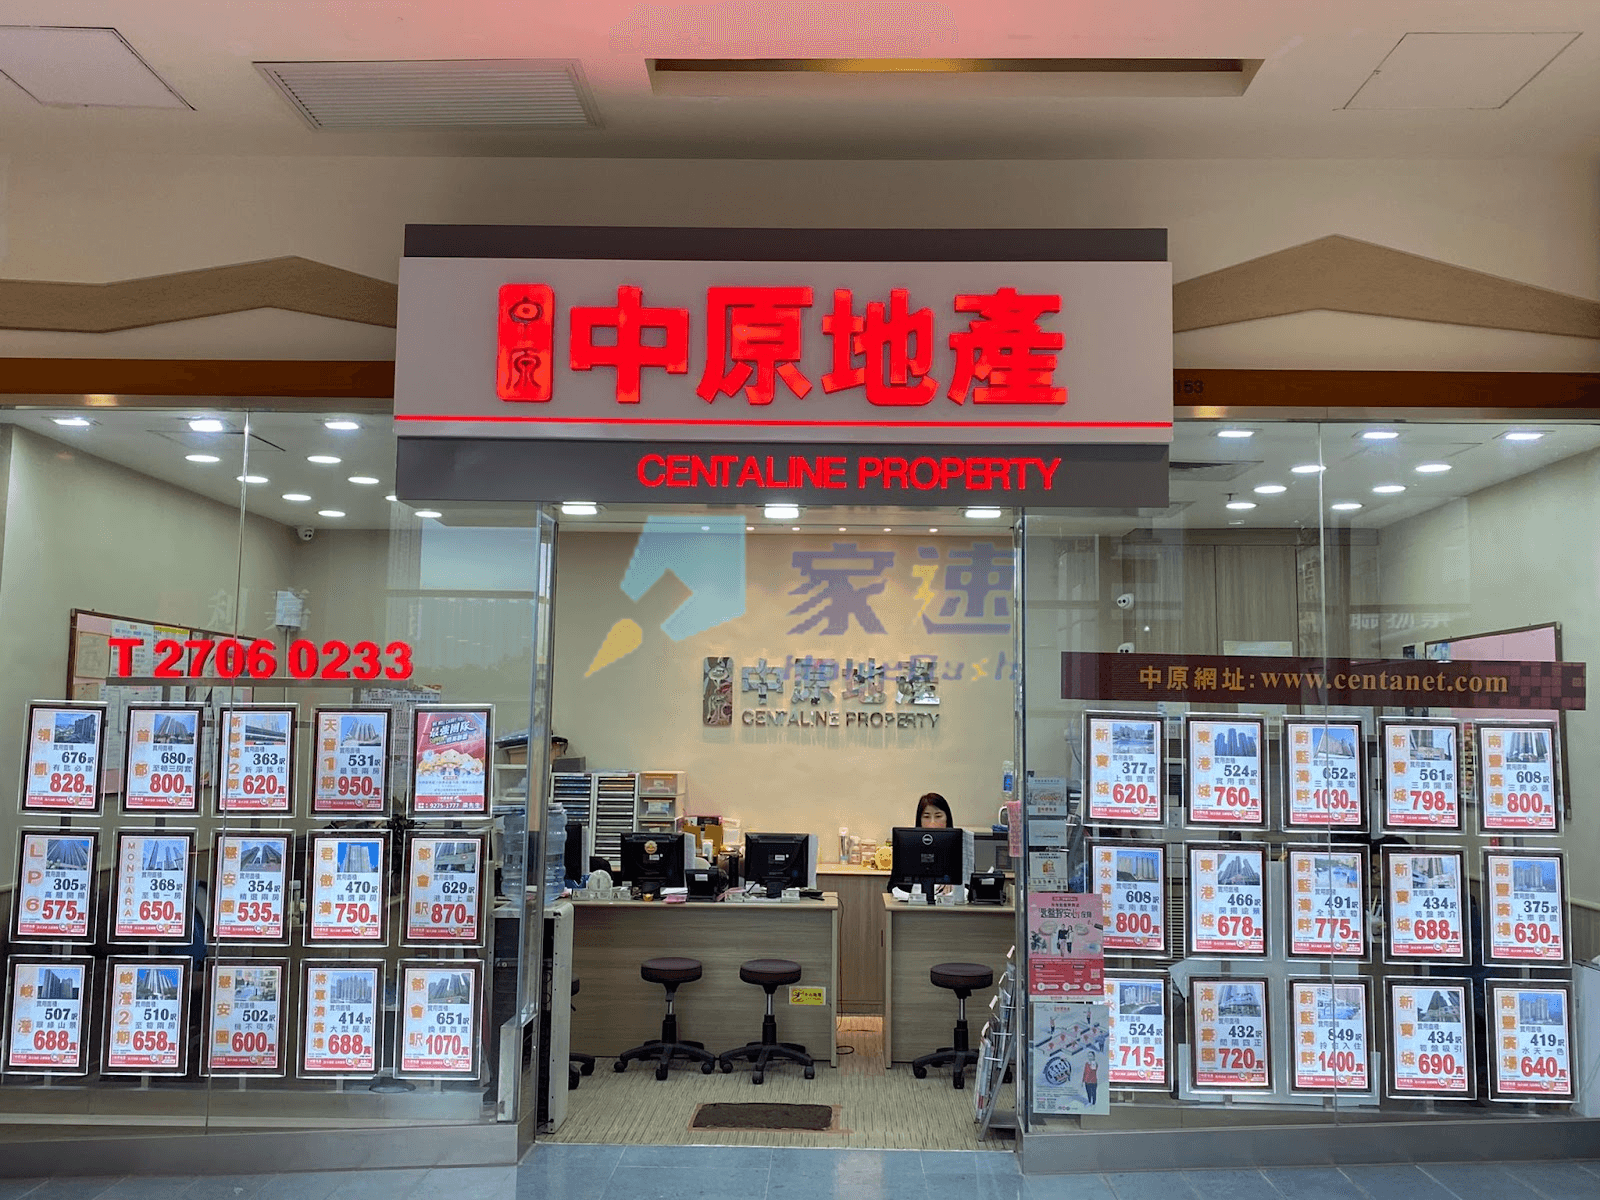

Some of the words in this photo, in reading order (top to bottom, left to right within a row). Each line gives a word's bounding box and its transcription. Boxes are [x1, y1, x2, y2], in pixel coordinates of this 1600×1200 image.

[568, 284, 1069, 406] 中原地產
[637, 453, 847, 491] CENTALINE
[859, 455, 1062, 492] PROPERTY
[108, 638, 144, 678] T
[154, 638, 277, 679] 2706
[288, 640, 414, 680] 0233
[741, 710, 840, 728] CENTALINE
[845, 710, 941, 729] PROPERTY
[51, 773, 93, 793] 828萬
[150, 774, 192, 793] 800萬
[243, 776, 287, 794] 620萬
[338, 777, 382, 796] 950萬
[1113, 784, 1158, 804] 620萬
[1215, 787, 1259, 807] 760萬
[1410, 791, 1456, 811] 798萬
[1508, 793, 1552, 813] 800萬
[43, 900, 86, 920] 575萬
[139, 901, 183, 921] 650萬
[238, 902, 281, 922] 535萬
[336, 904, 379, 923] 750萬
[431, 904, 475, 924] 870萬
[1117, 914, 1160, 934] 800萬
[1217, 916, 1262, 937] 678萬
[1414, 920, 1460, 940] 688萬
[1514, 923, 1561, 944] 630萬
[34, 1031, 78, 1050] 688萬
[132, 1031, 177, 1051] 658萬
[232, 1032, 276, 1052] 600萬
[329, 1035, 373, 1054] 688萬
[426, 1036, 469, 1055] 1070萬
[1120, 1046, 1163, 1067] 715萬
[1219, 1049, 1264, 1069] 720萬
[1419, 1054, 1464, 1074] 690萬
[1521, 1057, 1567, 1078] 640萬
